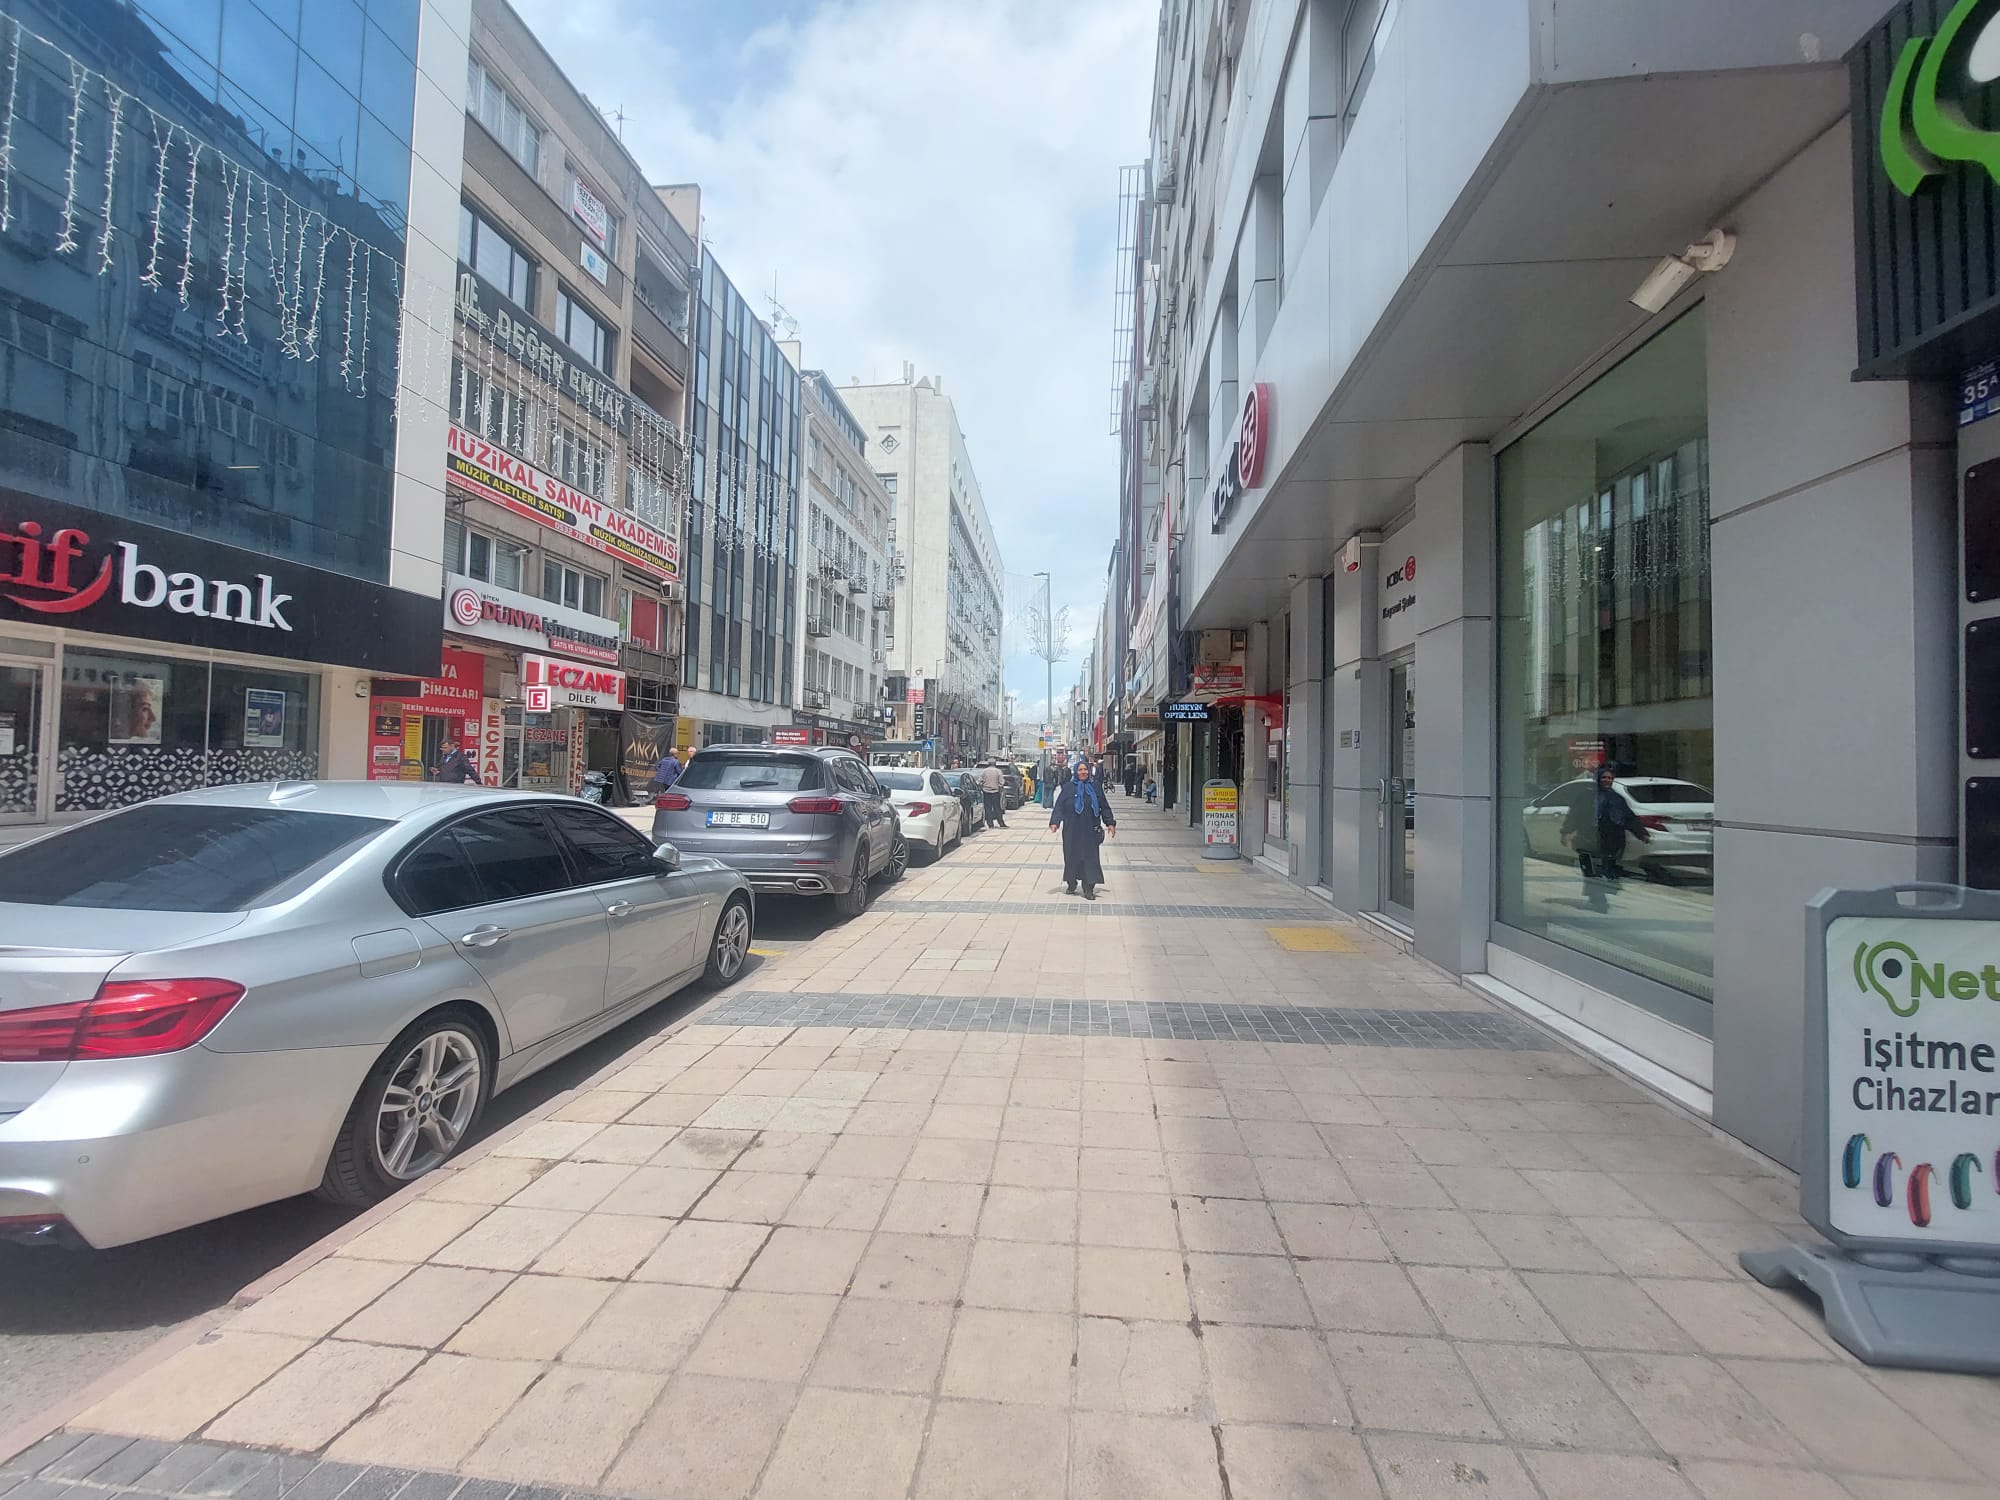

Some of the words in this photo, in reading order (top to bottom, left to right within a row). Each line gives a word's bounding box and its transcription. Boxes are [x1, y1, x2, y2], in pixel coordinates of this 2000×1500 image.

[456, 458, 491, 486] MÜZİK
[493, 478, 537, 506] ALETLERİ
[538, 499, 565, 521] SATIŞI
[545, 479, 602, 522] SANAT
[594, 527, 616, 547] MÜZİK
[115, 541, 293, 631] bank
[1386, 566, 1404, 590] ICBC
[482, 601, 543, 633] DÜNYA
[548, 664, 618, 696] ECZANE
[568, 692, 597, 705] DİLEK
[527, 728, 566, 742] ECZANE
[713, 812, 724, 823] 38
[730, 812, 742, 823] BE
[750, 813, 767, 824] 610
[1206, 820, 1236, 829] signia
[1911, 962, 2000, 1001] Net
[1863, 1028, 1996, 1073] işitme
[1852, 1076, 2000, 1117] Cihazlar
